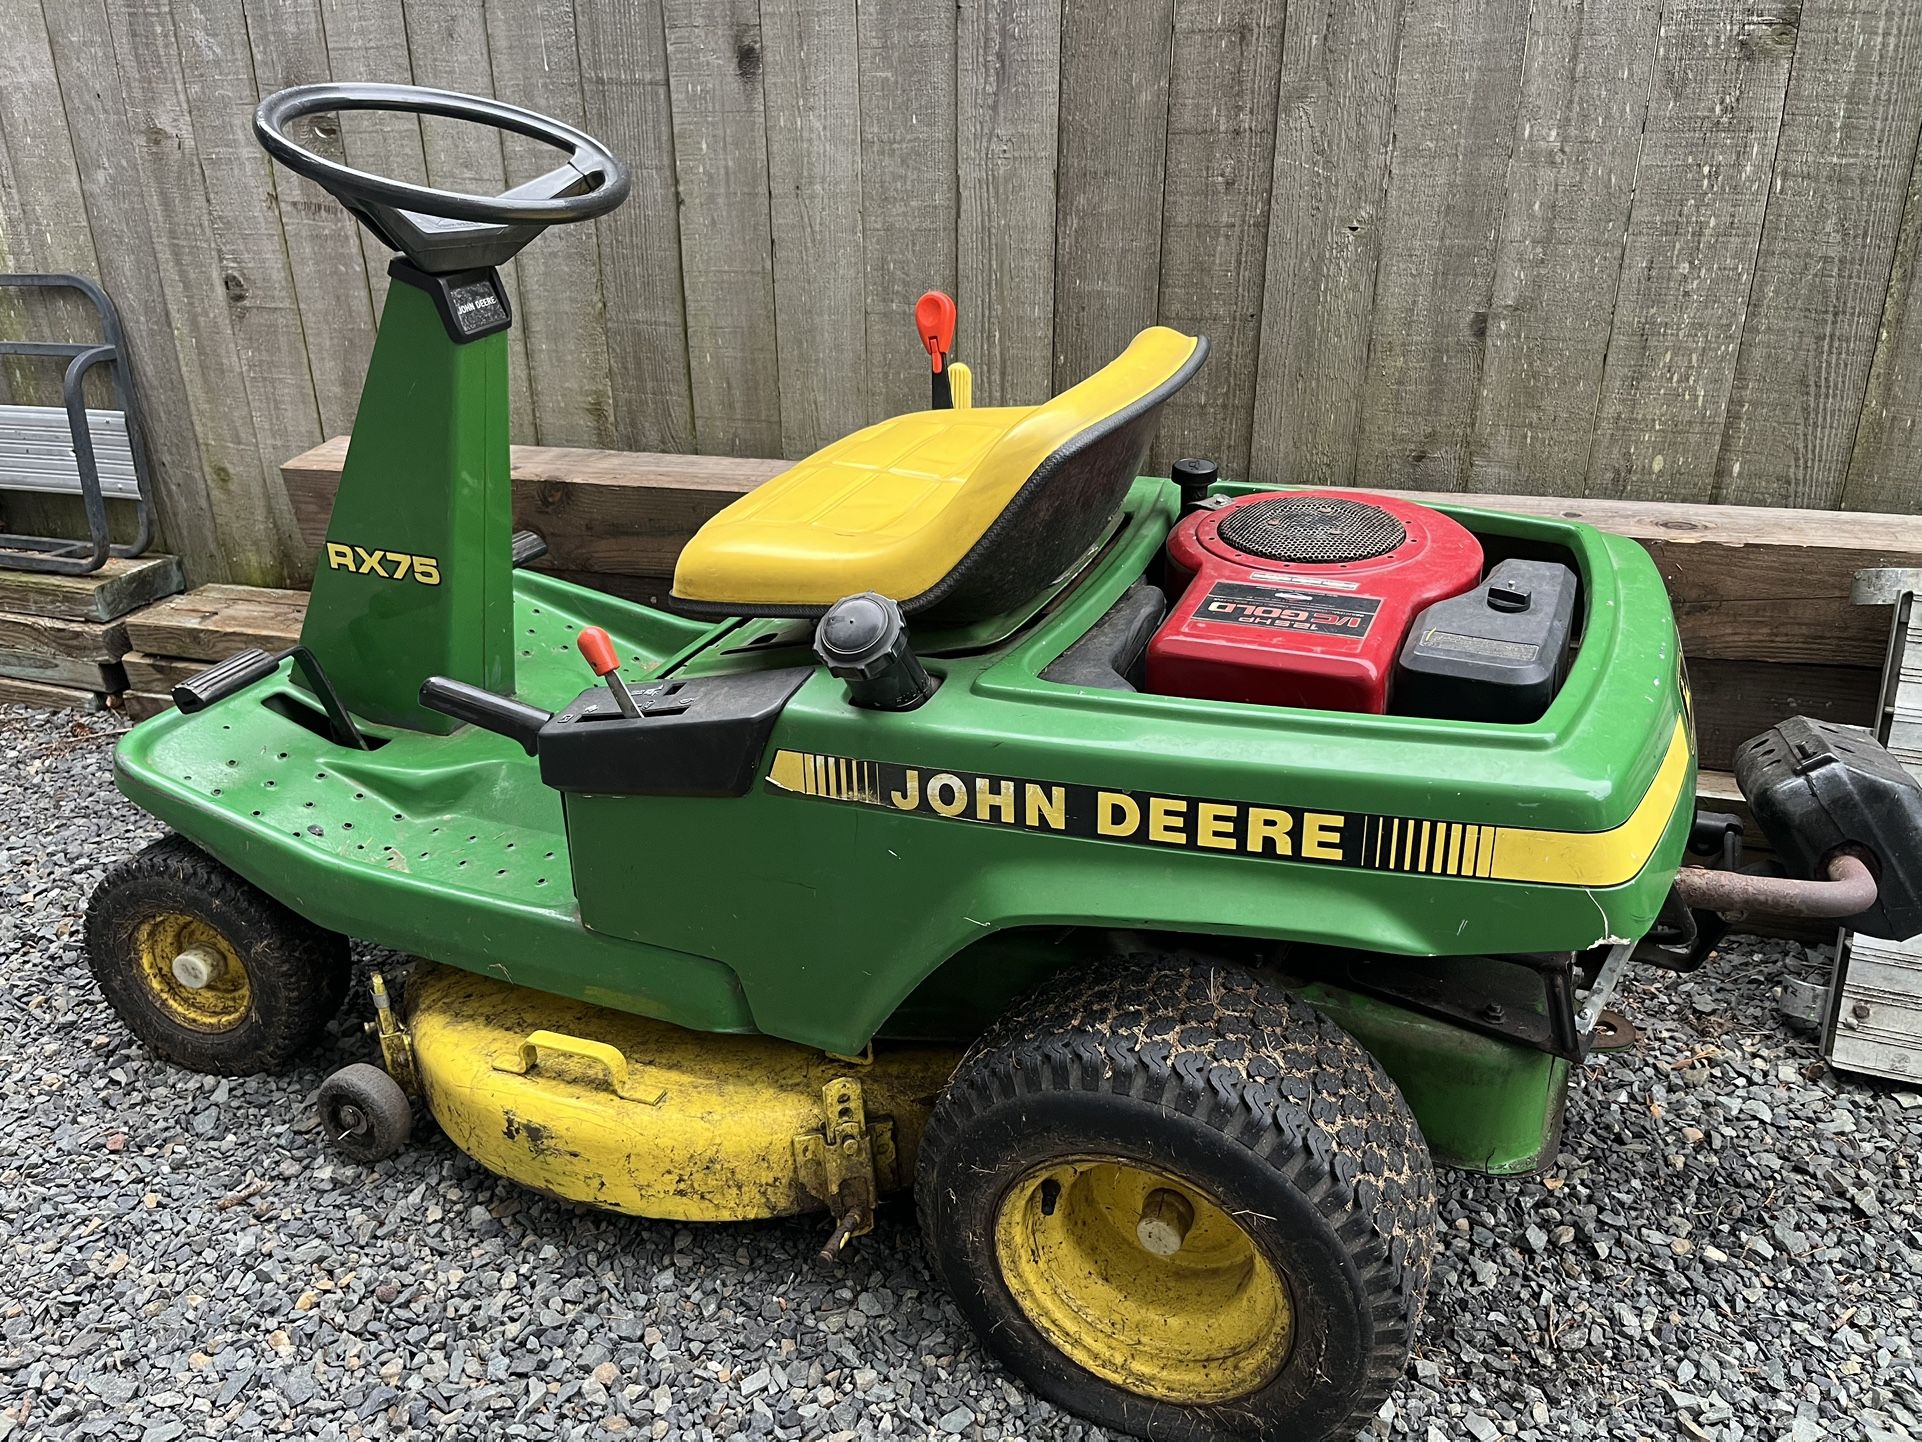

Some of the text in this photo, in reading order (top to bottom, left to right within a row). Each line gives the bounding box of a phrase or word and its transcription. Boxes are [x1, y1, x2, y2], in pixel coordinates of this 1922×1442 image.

[458, 296, 497, 315] JOHN DEERE
[326, 542, 441, 585] RX75
[1207, 601, 1309, 621] GOLD
[1310, 613, 1362, 628] I/C
[1238, 616, 1319, 631] 12.5 HP
[891, 769, 1344, 861] JOHN DEERE
